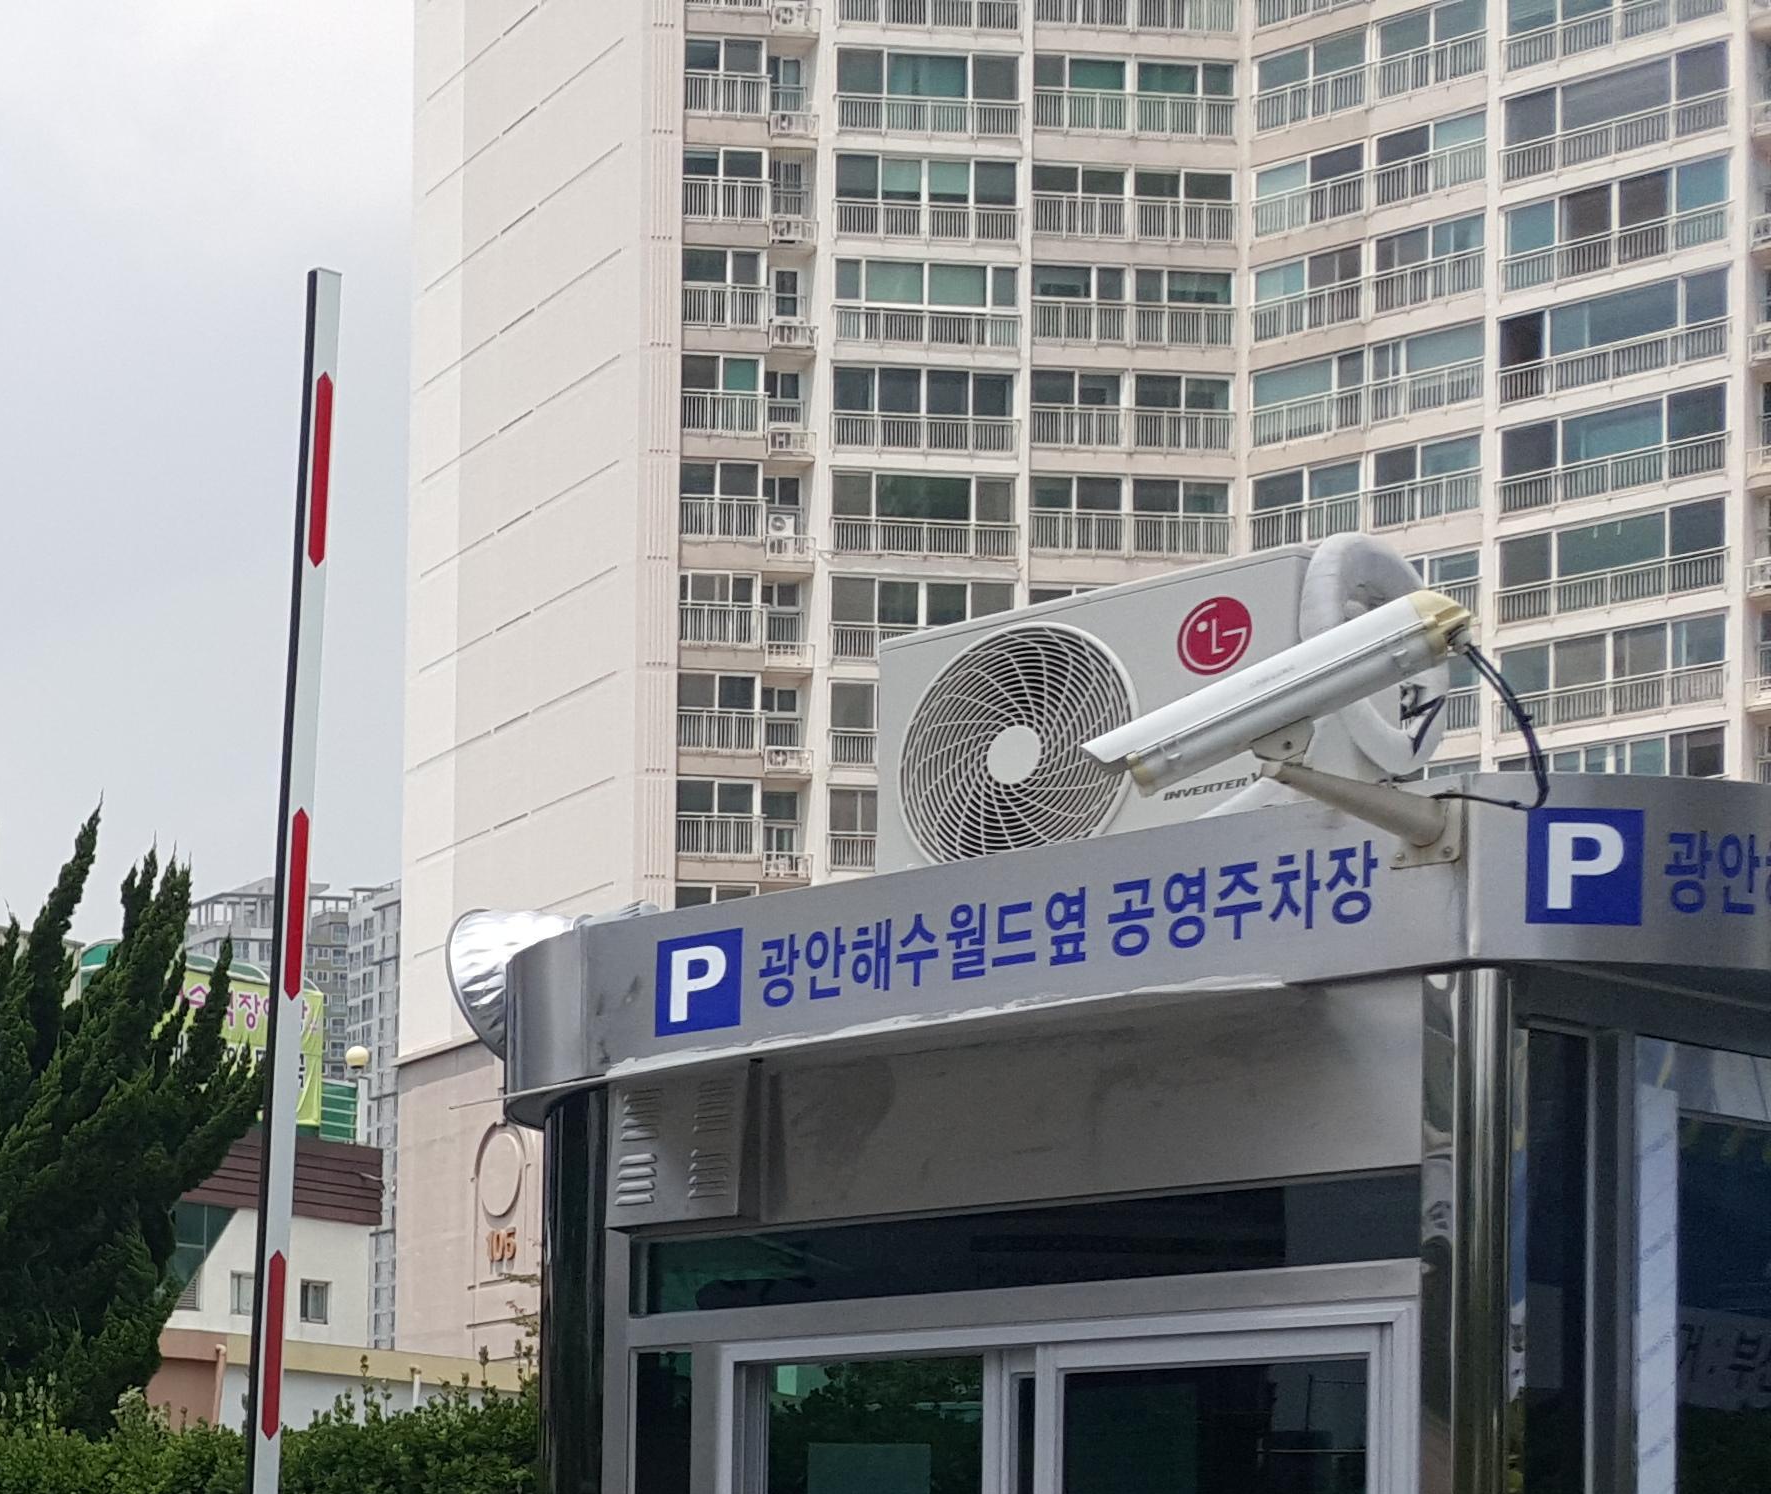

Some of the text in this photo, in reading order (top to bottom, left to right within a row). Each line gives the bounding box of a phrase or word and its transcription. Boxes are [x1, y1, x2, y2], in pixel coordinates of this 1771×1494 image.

[1178, 596, 1252, 676] LG
[1163, 777, 1248, 801] INVERTER
[1547, 822, 1624, 909] P
[1665, 830, 1771, 915] 광안
[759, 841, 1377, 1007] 광안해수월드옆 공영주차장
[669, 946, 724, 1020] P
